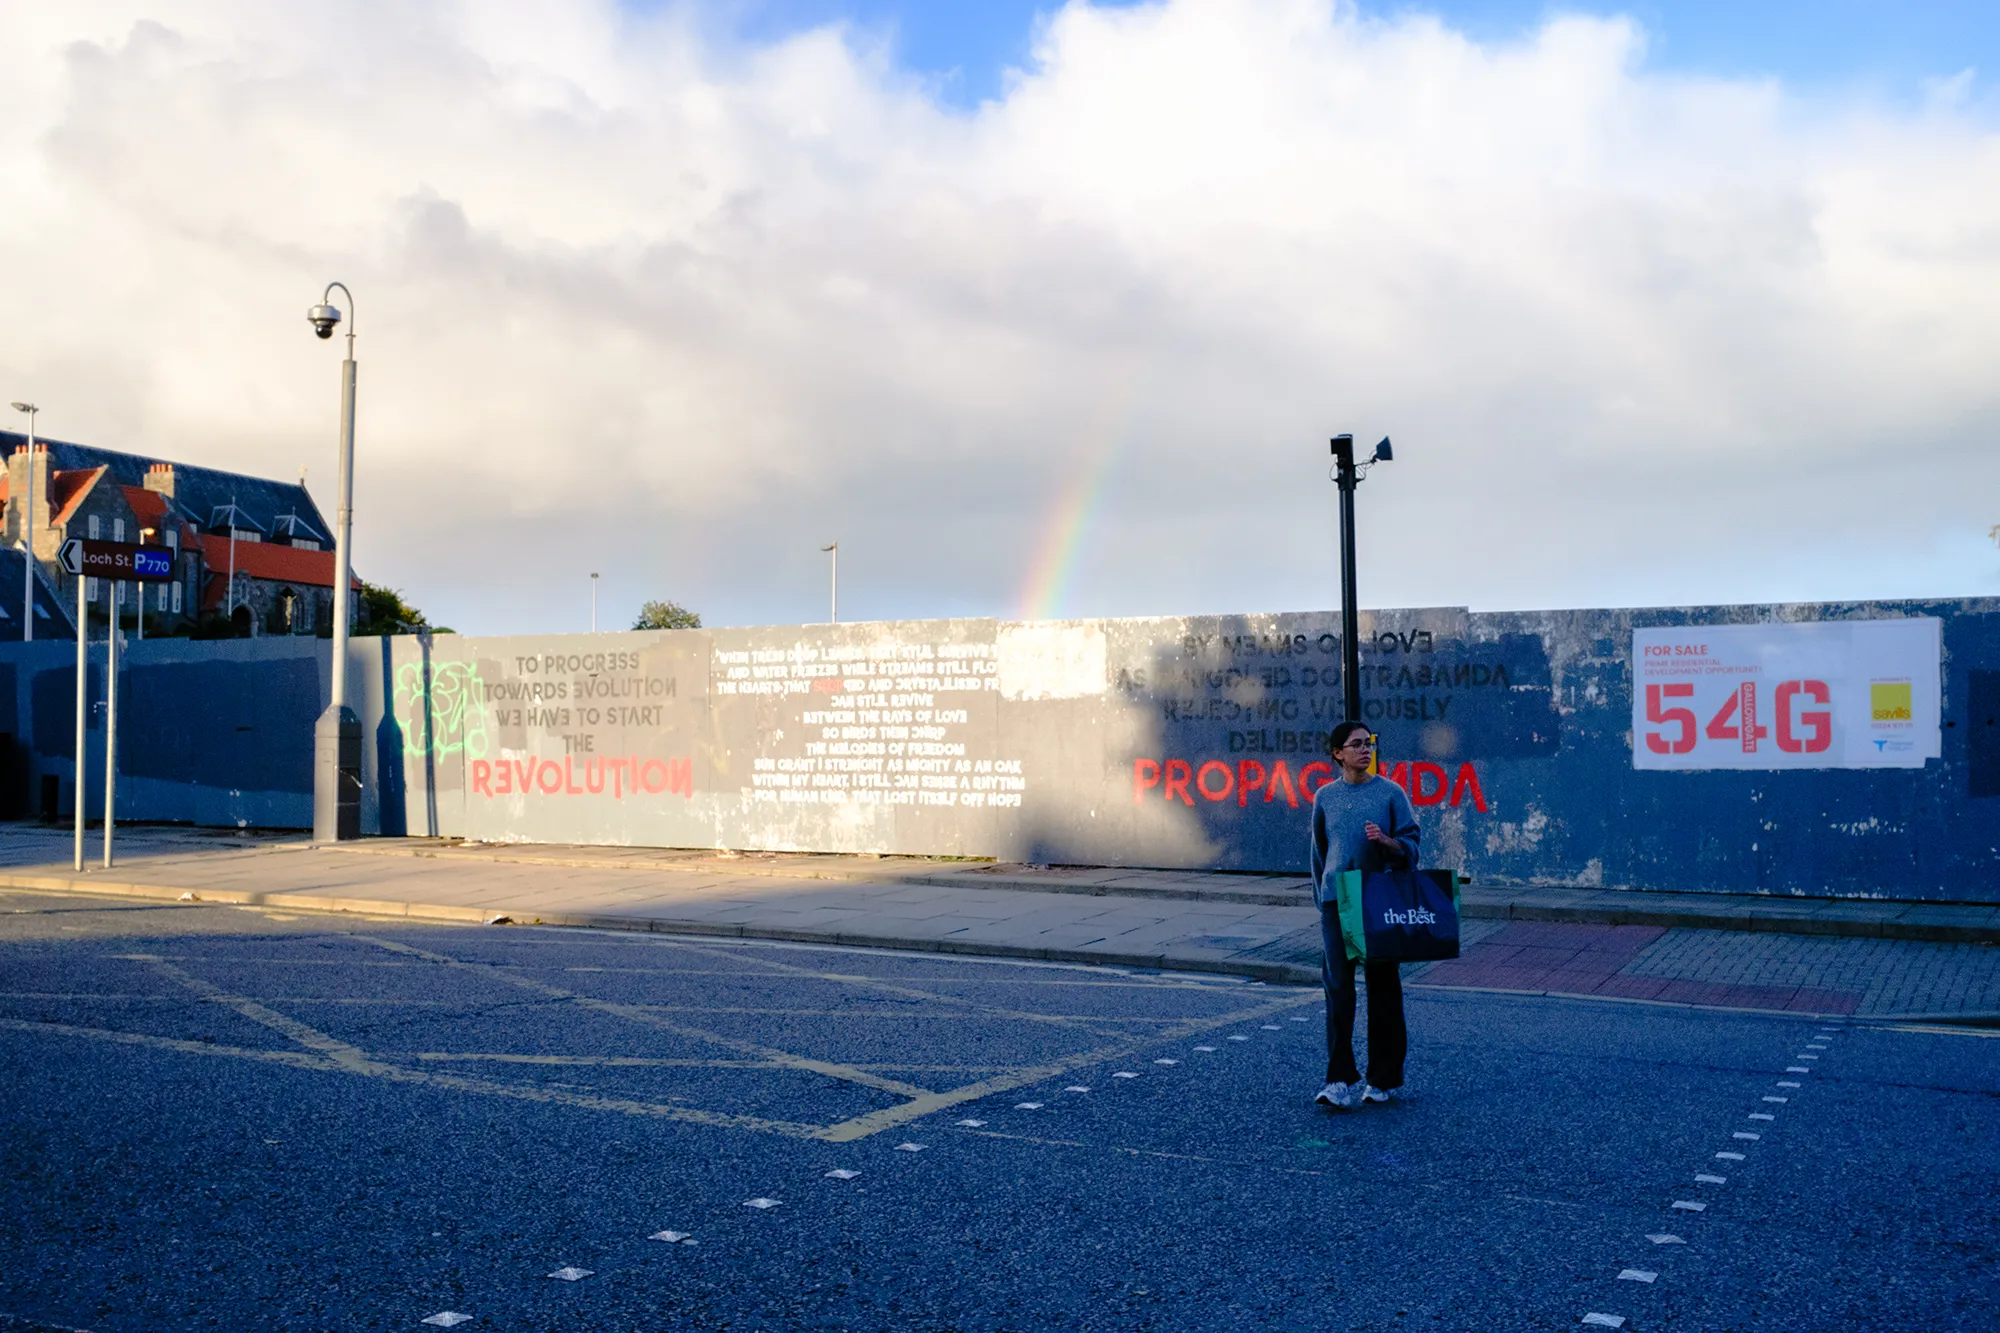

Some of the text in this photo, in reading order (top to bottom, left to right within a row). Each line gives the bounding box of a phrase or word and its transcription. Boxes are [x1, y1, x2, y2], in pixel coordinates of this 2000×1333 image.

[82, 551, 112, 565] Loch
[115, 553, 133, 566] St.
[1223, 634, 1308, 659] MEANS
[1317, 633, 1343, 655] O
[1644, 644, 1709, 657] FOR SALE
[516, 652, 640, 675] TO PROGRESS
[727, 661, 998, 679] AND WATER FREEZES WHILE STREAMS STILL FLO
[1644, 658, 1721, 668] PRIME RESIDENTIAL
[1299, 664, 1511, 691] COTRABANDA
[1644, 667, 1703, 677] DEVELOPMENT
[484, 677, 677, 702] TOWARDS EVOLUTION
[717, 682, 737, 694] THE
[783, 680, 811, 694] THAT
[868, 679, 893, 692] AND
[831, 693, 933, 708] CAN STILL REVIVE
[1310, 694, 1453, 721] VIOUSLY
[495, 705, 664, 728] WE HAVE TO START
[803, 709, 967, 724] BETWEEN THE RAYS OF LOVE
[1873, 706, 1911, 720] savills
[822, 726, 839, 739] SO
[562, 733, 594, 754] THE
[806, 742, 964, 756] THE MELODIES OF FREEDOM
[1229, 728, 1334, 757] DELIBER
[887, 759, 903, 772] AS
[906, 758, 951, 772] MIGHTY
[954, 760, 971, 773] AS
[974, 760, 992, 773] AN
[994, 760, 1022, 774] OAK
[472, 754, 692, 799] REVOLUTION
[792, 773, 810, 787] MY
[852, 773, 857, 787] I
[859, 773, 891, 787] STILL
[894, 775, 918, 788] CAN
[960, 776, 970, 789] A
[1133, 757, 1488, 813] PROPAGNDA
[884, 790, 916, 804] LOST
[960, 792, 985, 807] OFF
[987, 792, 1022, 807] HOPE
[1384, 908, 1406, 924] the
